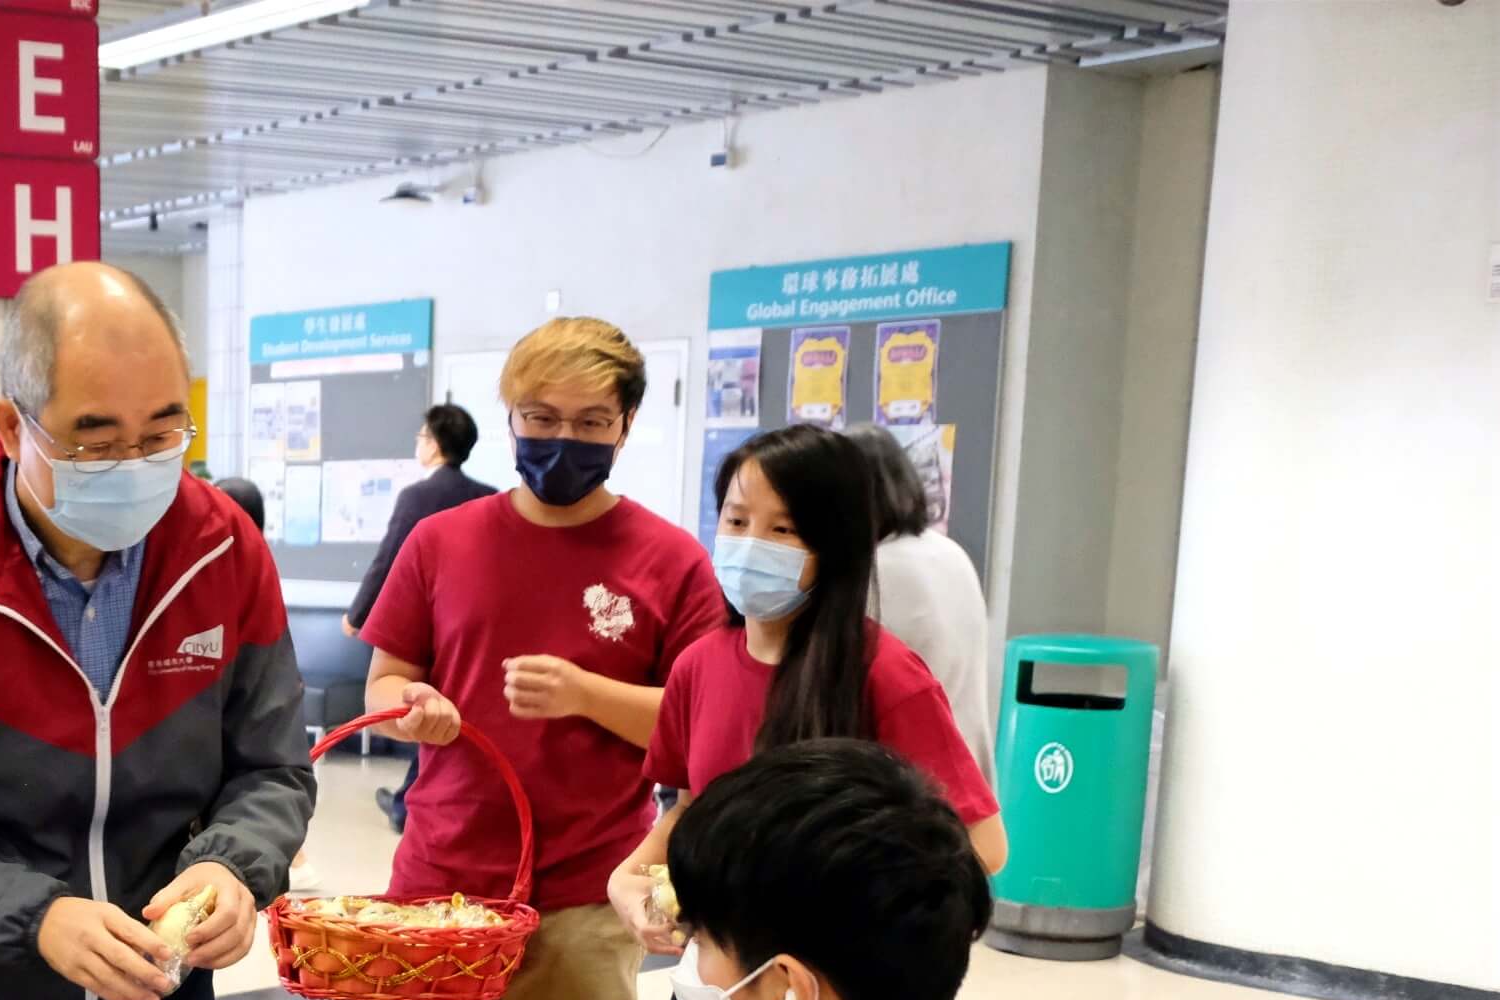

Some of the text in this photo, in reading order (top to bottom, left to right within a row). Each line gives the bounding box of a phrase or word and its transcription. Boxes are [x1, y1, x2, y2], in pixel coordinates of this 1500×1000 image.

[18, 40, 65, 134] E
[73, 140, 93, 153] LAU
[15, 183, 72, 273] H
[746, 287, 957, 320] Global Engagement Office
[183, 641, 219, 656] CityU
